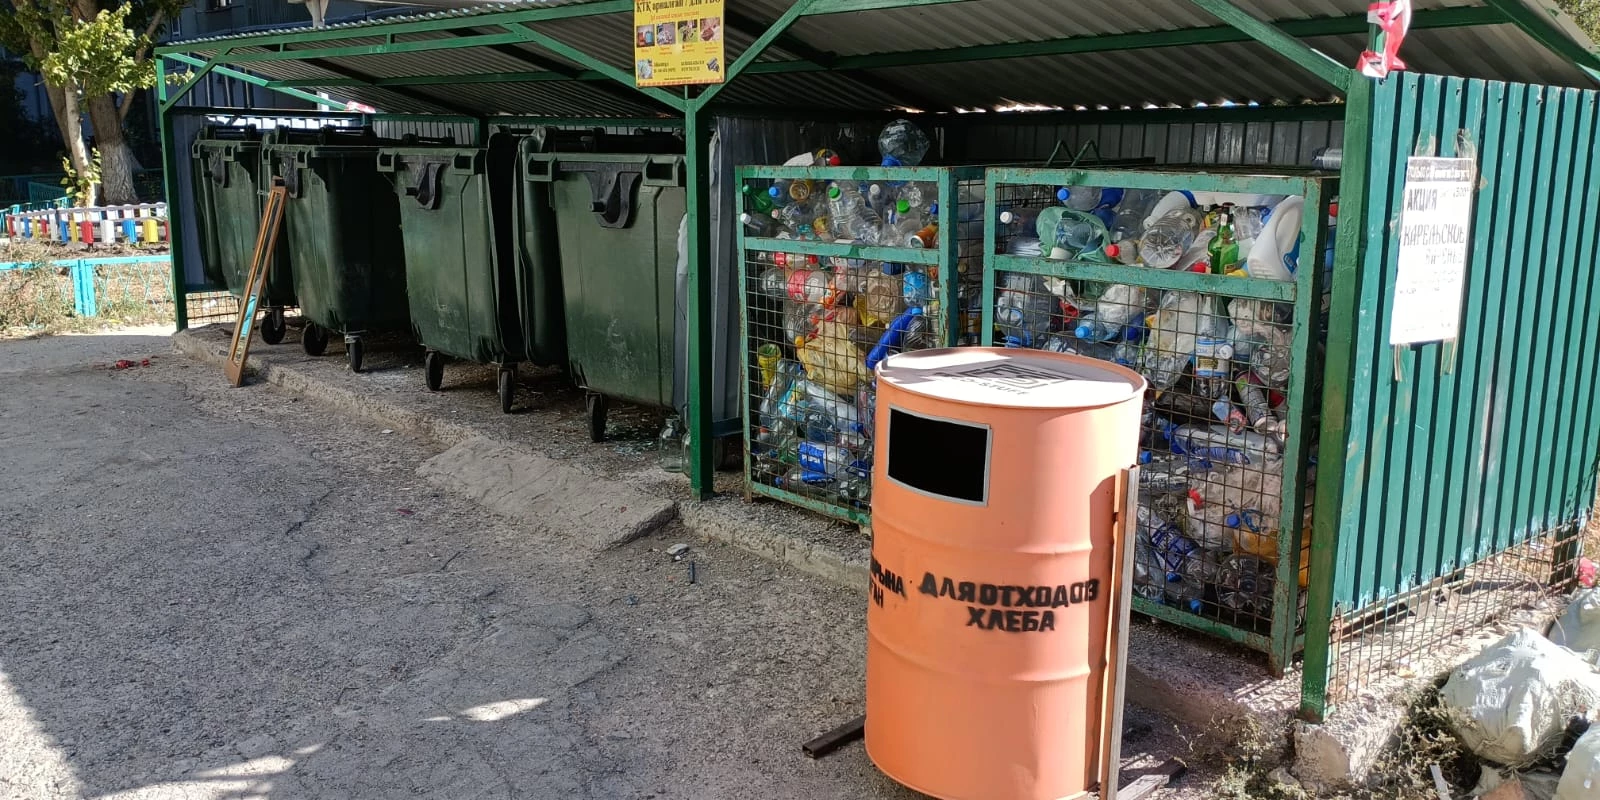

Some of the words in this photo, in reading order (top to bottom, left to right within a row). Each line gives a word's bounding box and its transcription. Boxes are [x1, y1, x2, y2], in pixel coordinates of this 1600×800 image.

[1407, 188, 1438, 212] АКЦИЯ
[1403, 224, 1465, 247] КАРЕЛЬСКОЕ
[966, 607, 1055, 633] ХЛЕБА
